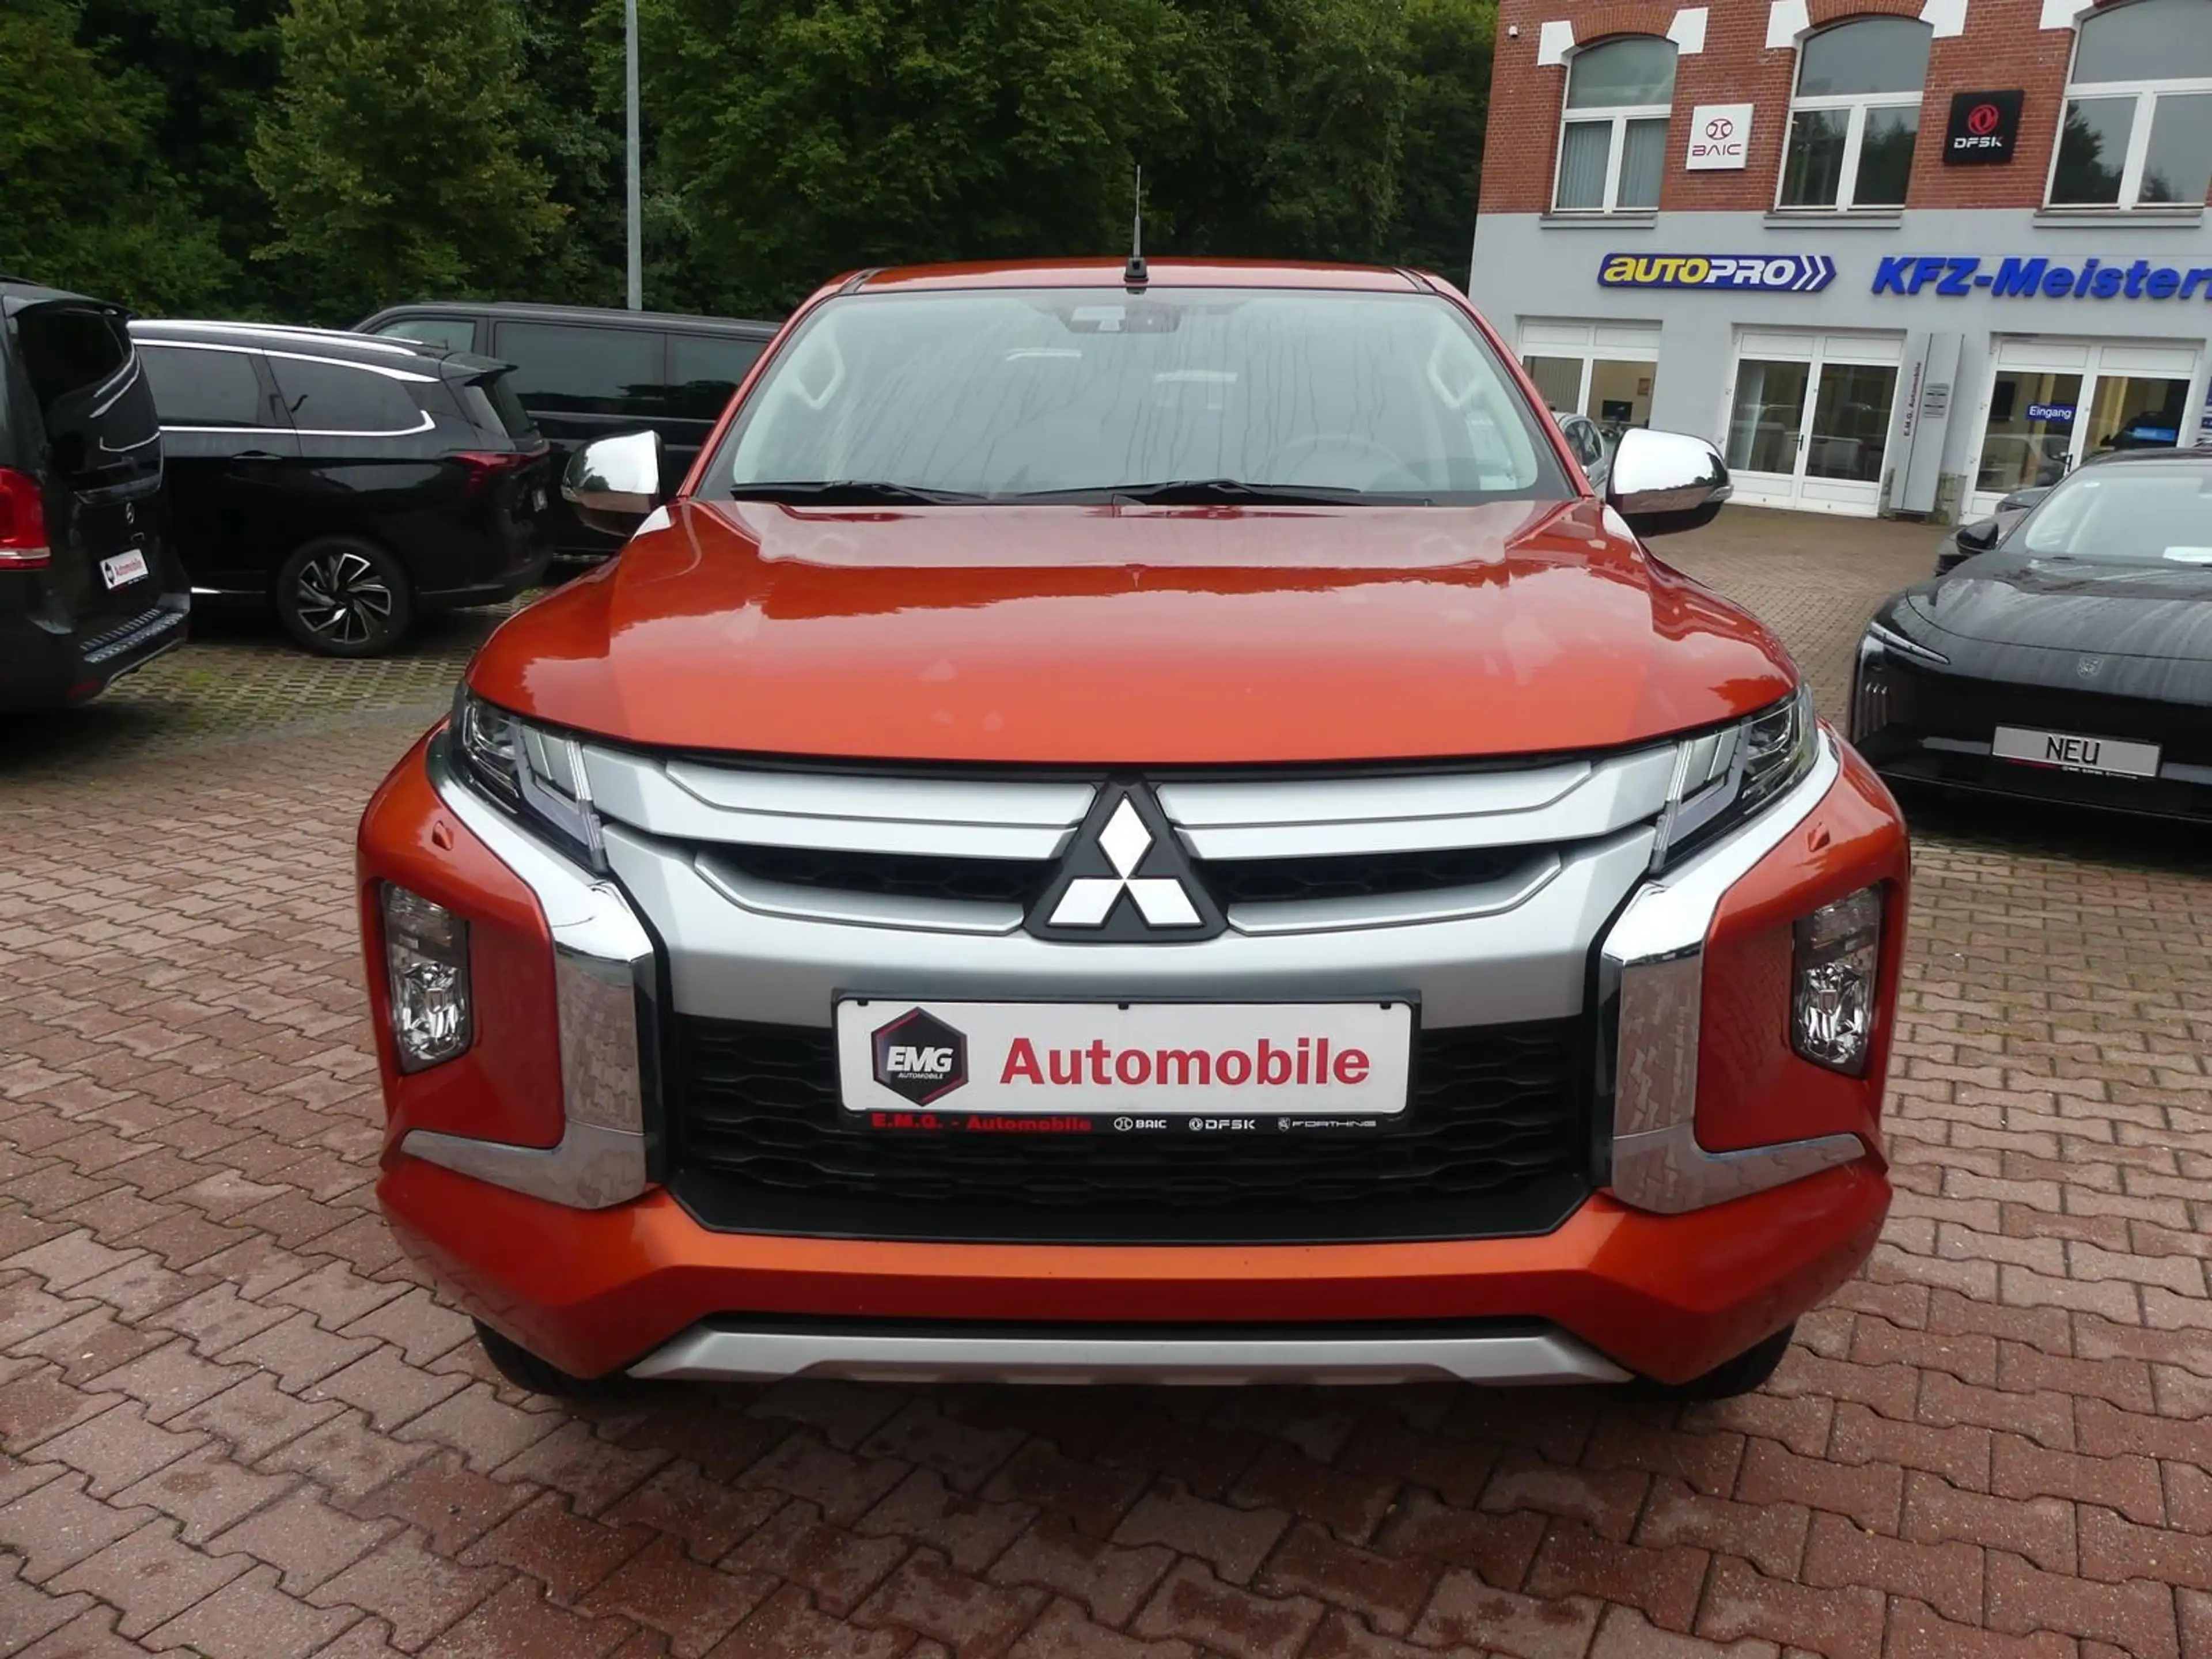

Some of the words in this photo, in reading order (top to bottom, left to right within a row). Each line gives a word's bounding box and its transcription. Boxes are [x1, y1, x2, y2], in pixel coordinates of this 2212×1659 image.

[1953, 136, 2003, 149] DFSK
[1692, 144, 1741, 156] BAIC
[1870, 256, 2212, 300] KFZ-Meister
[2029, 406, 2072, 419] Eingang
[2046, 736, 2101, 765] NEU
[886, 1046, 954, 1073] EMG
[999, 1037, 1371, 1085] Automobile
[966, 1115, 1092, 1132] Automobile
[1135, 1119, 1168, 1129] BAIC
[1205, 1119, 1256, 1129] DFSK
[1292, 1120, 1377, 1128] FORTHING
